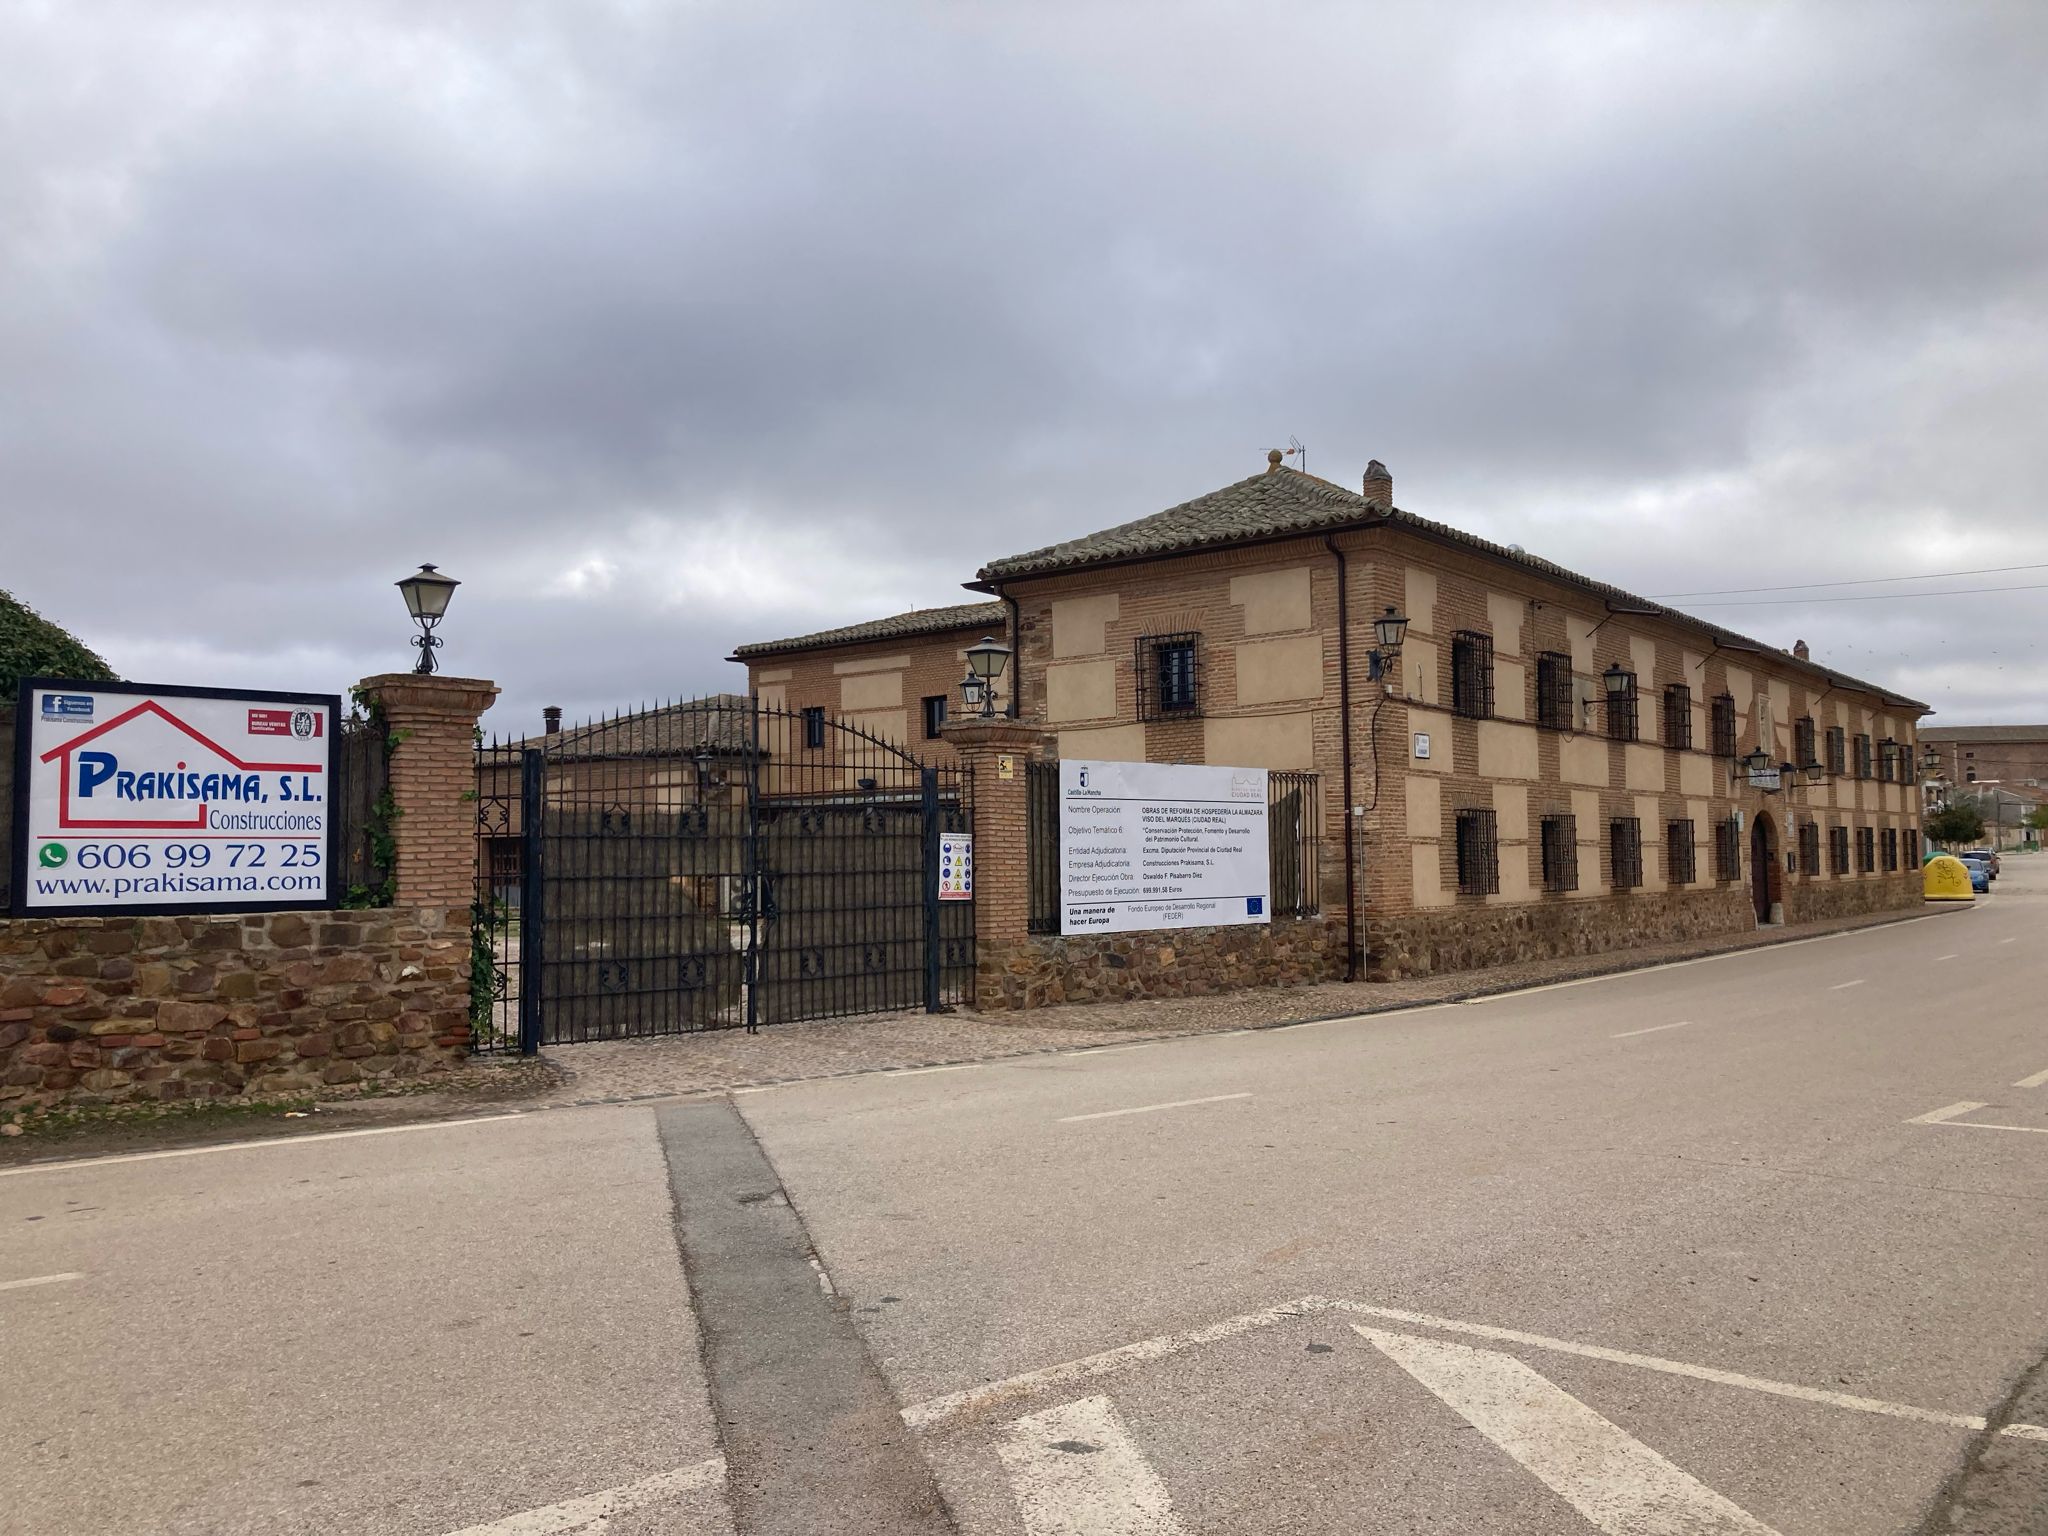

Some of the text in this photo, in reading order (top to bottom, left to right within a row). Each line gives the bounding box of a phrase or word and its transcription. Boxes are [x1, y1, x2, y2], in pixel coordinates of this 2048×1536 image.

[279, 775, 322, 802] S.L.
[1169, 807, 1193, 815] REFORMA
[209, 809, 321, 831] Construcciones
[1211, 816, 1226, 824] REAL)
[1068, 826, 1091, 835] Objetivo
[1068, 847, 1090, 855] Entidad
[77, 843, 321, 869] 606 99 72 25
[1068, 860, 1094, 869] Empresa
[1180, 859, 1205, 867] Prakisama,
[1068, 874, 1090, 883] Director
[1120, 873, 1134, 881] Obra
[35, 872, 321, 899] www.prakisama.com
[1068, 888, 1104, 898] Presupuesto
[1082, 907, 1106, 915] manera
[1144, 904, 1164, 913] Europeo
[1196, 902, 1216, 910] Regional
[1162, 912, 1184, 920] (FEDER)
[1069, 917, 1110, 926] hacer Europa
